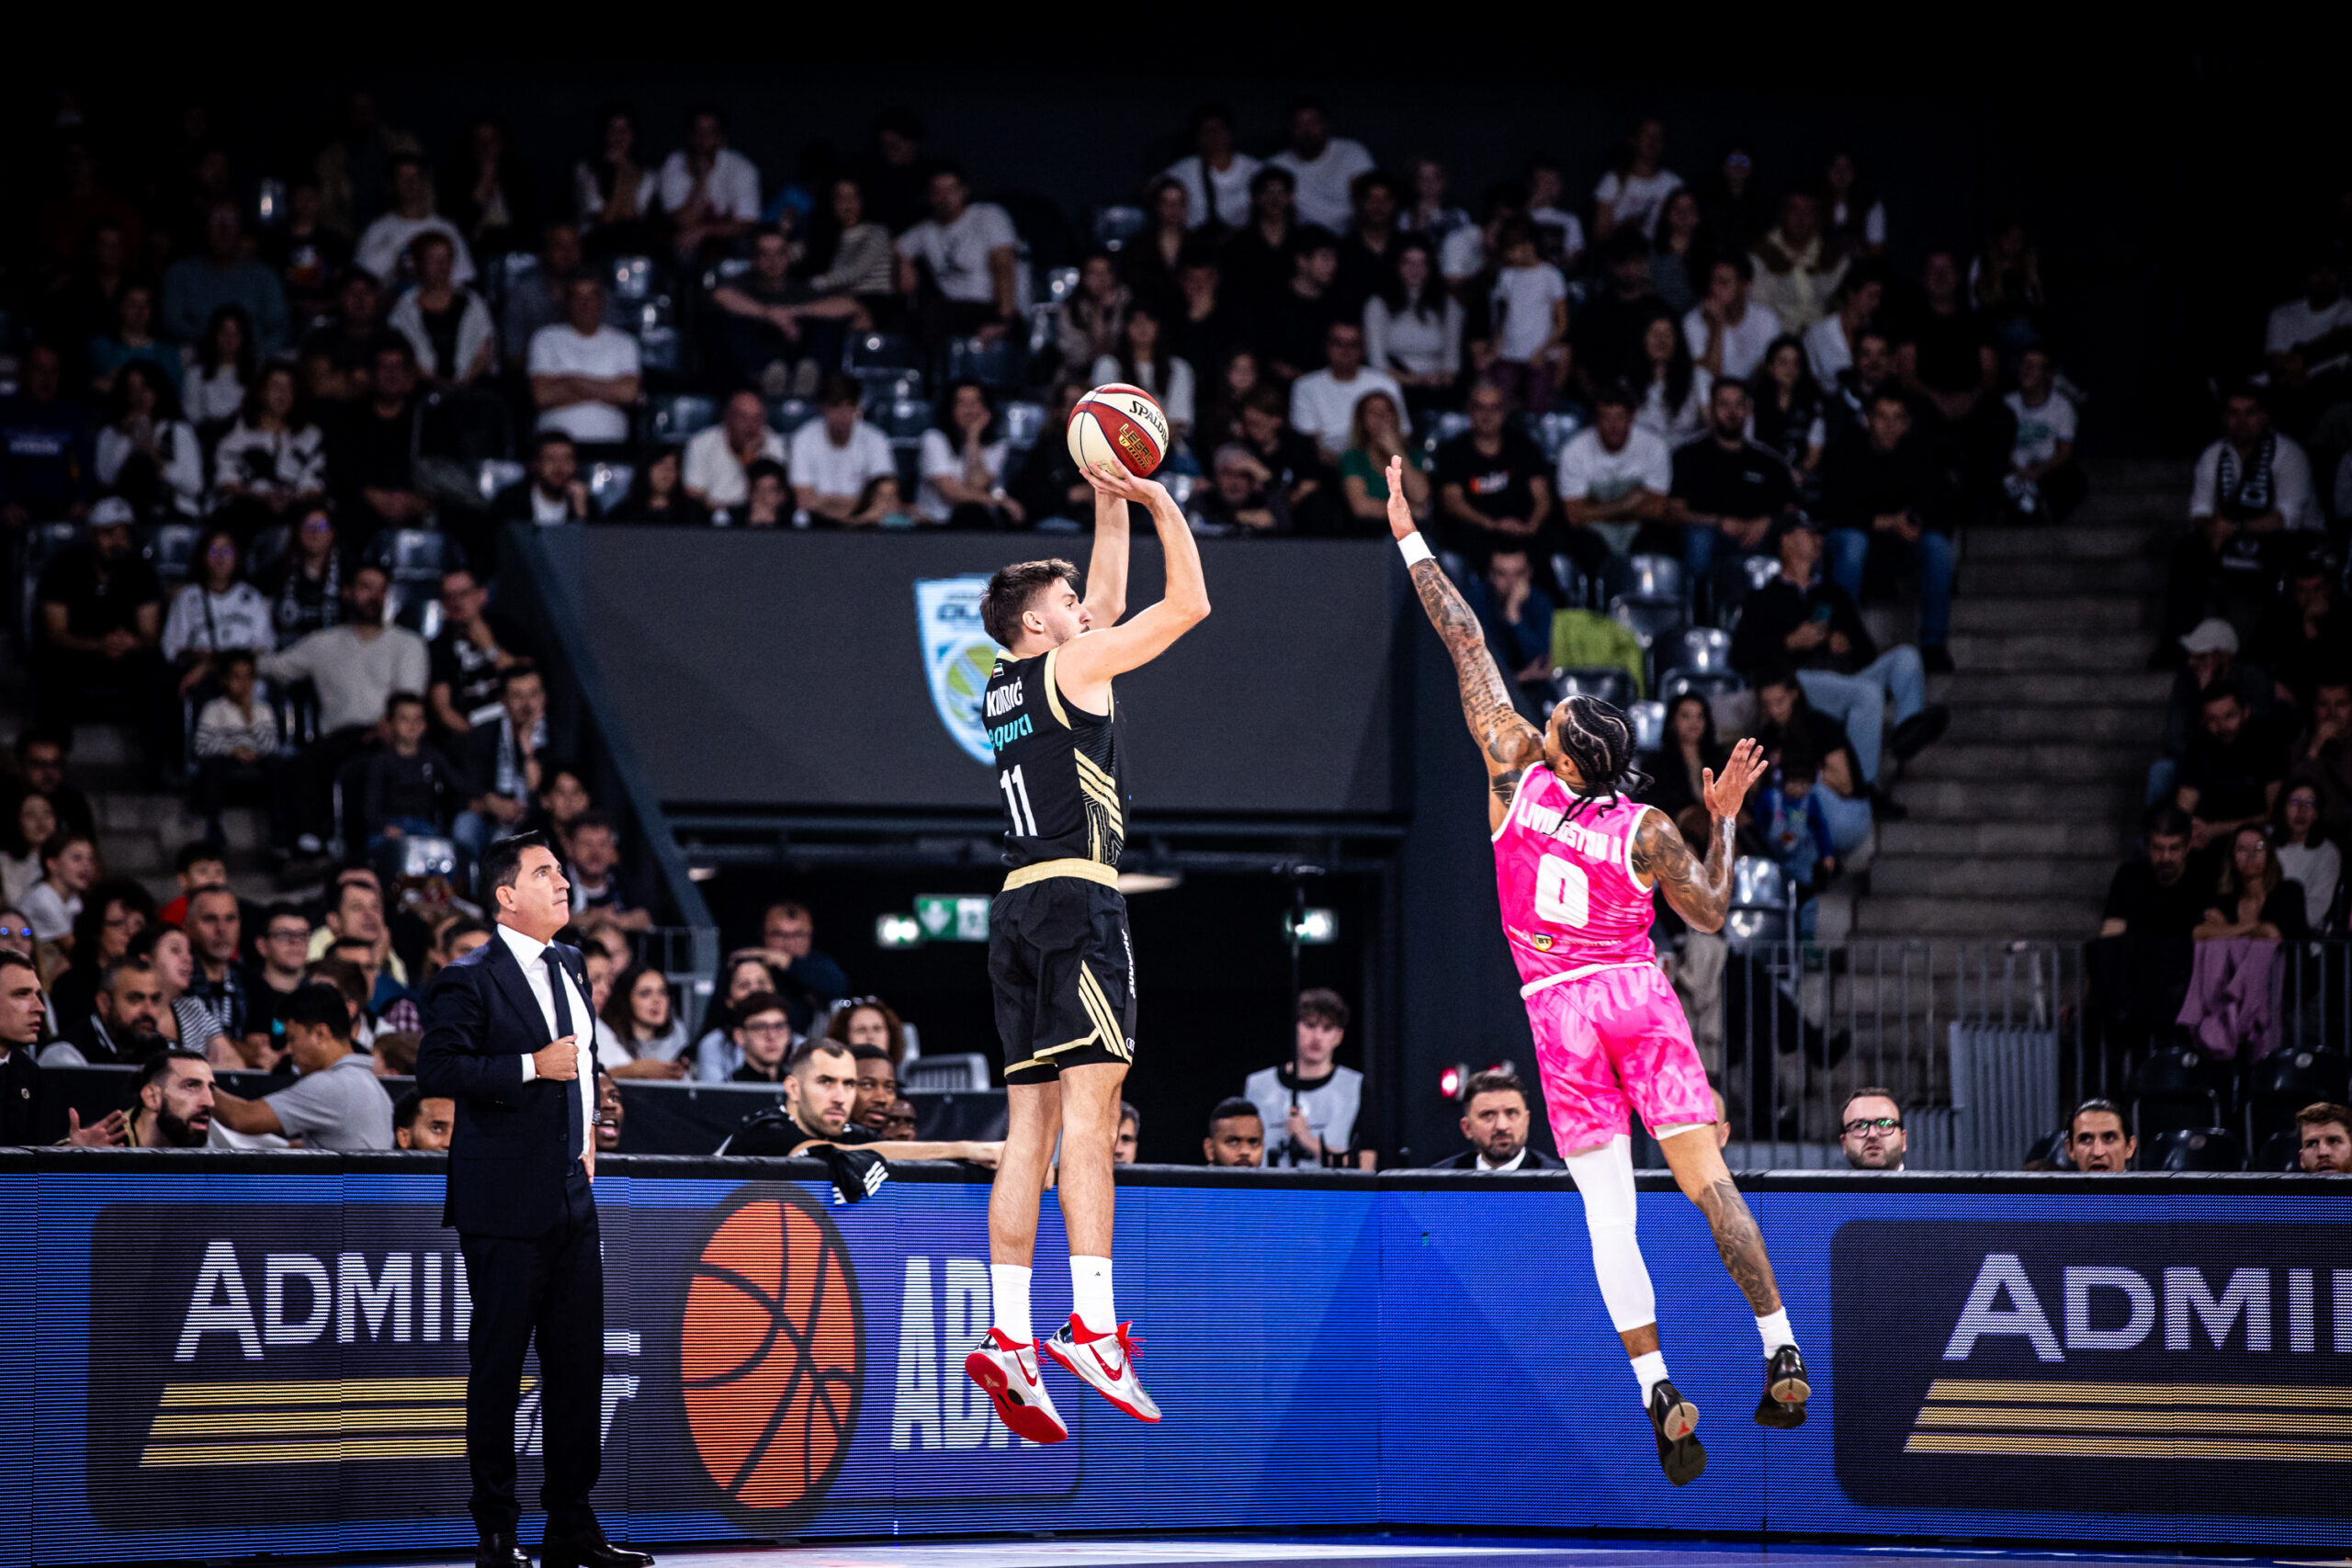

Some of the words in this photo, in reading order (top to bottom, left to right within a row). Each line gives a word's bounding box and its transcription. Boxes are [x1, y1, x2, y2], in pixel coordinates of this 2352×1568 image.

[1119, 423, 1155, 466] LEGACY
[1000, 764, 1038, 836] 11
[1535, 852, 1589, 929] 0
[1537, 937, 1549, 945] BT
[890, 1256, 1041, 1449] AB
